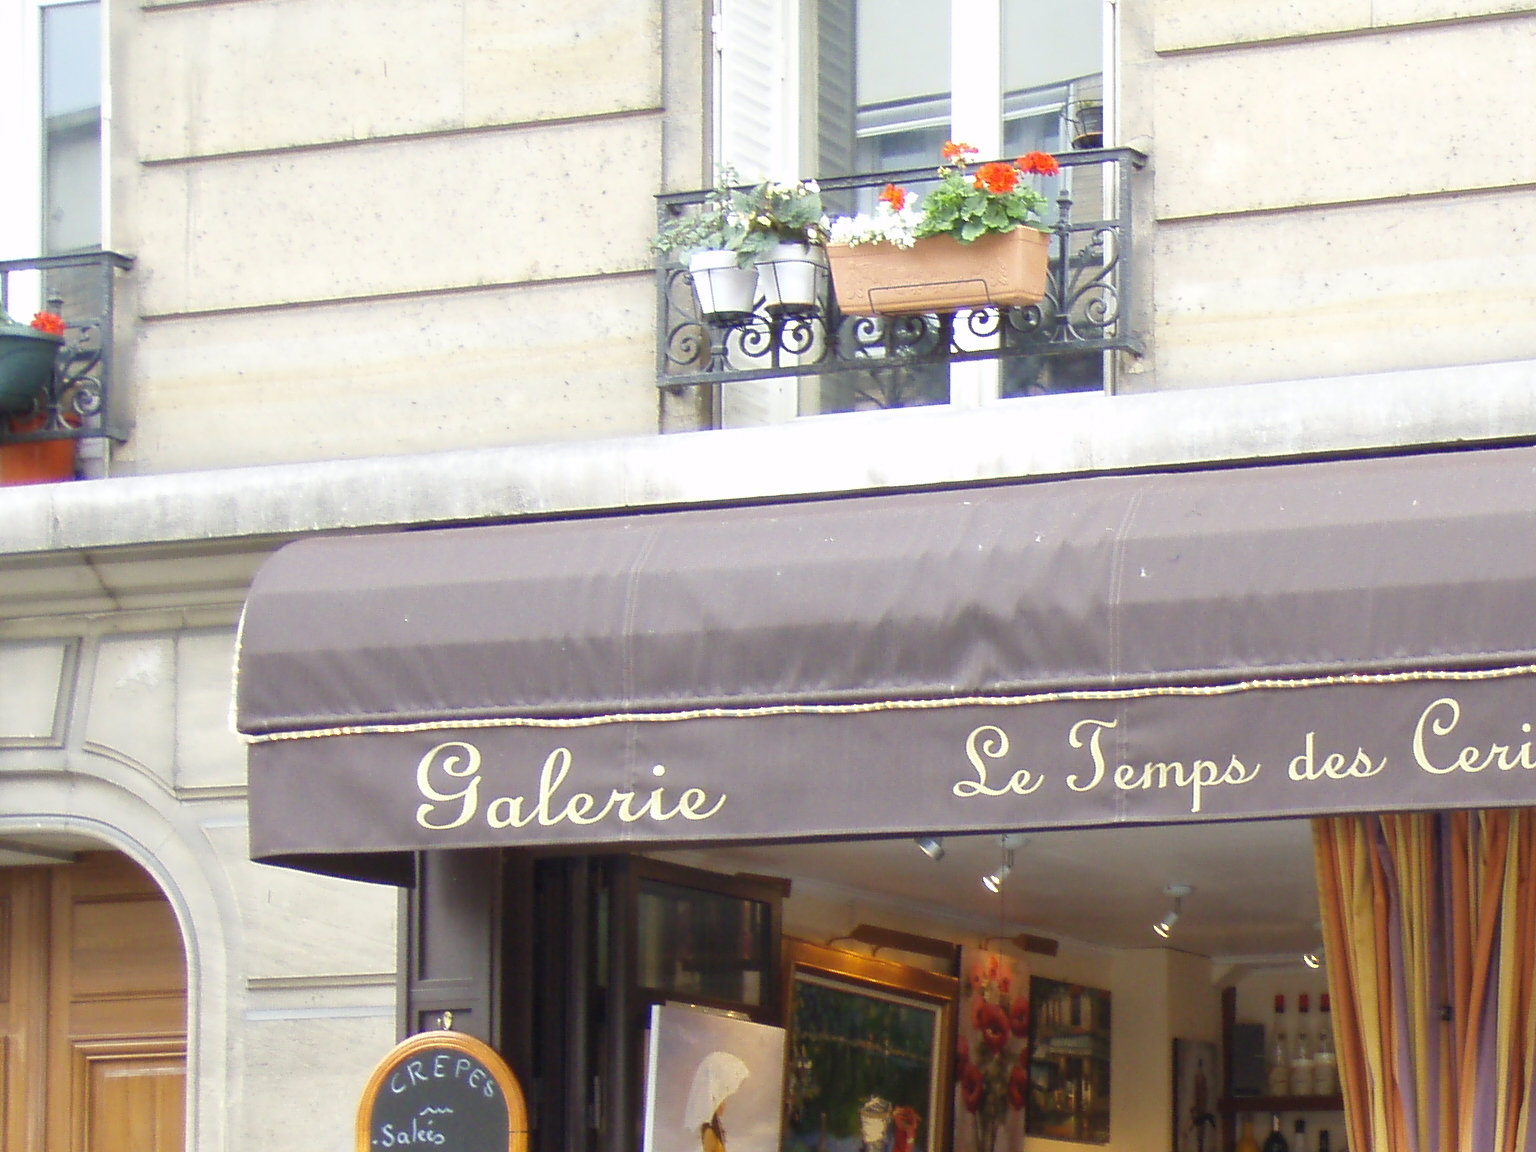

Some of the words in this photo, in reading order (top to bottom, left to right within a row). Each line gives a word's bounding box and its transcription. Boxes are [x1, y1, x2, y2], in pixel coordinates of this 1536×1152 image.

[416, 741, 727, 830] Galerie
[952, 724, 1045, 798] Le
[1065, 718, 1262, 812] Temps
[1287, 731, 1388, 782] des
[391, 1055, 495, 1098] CREPES
